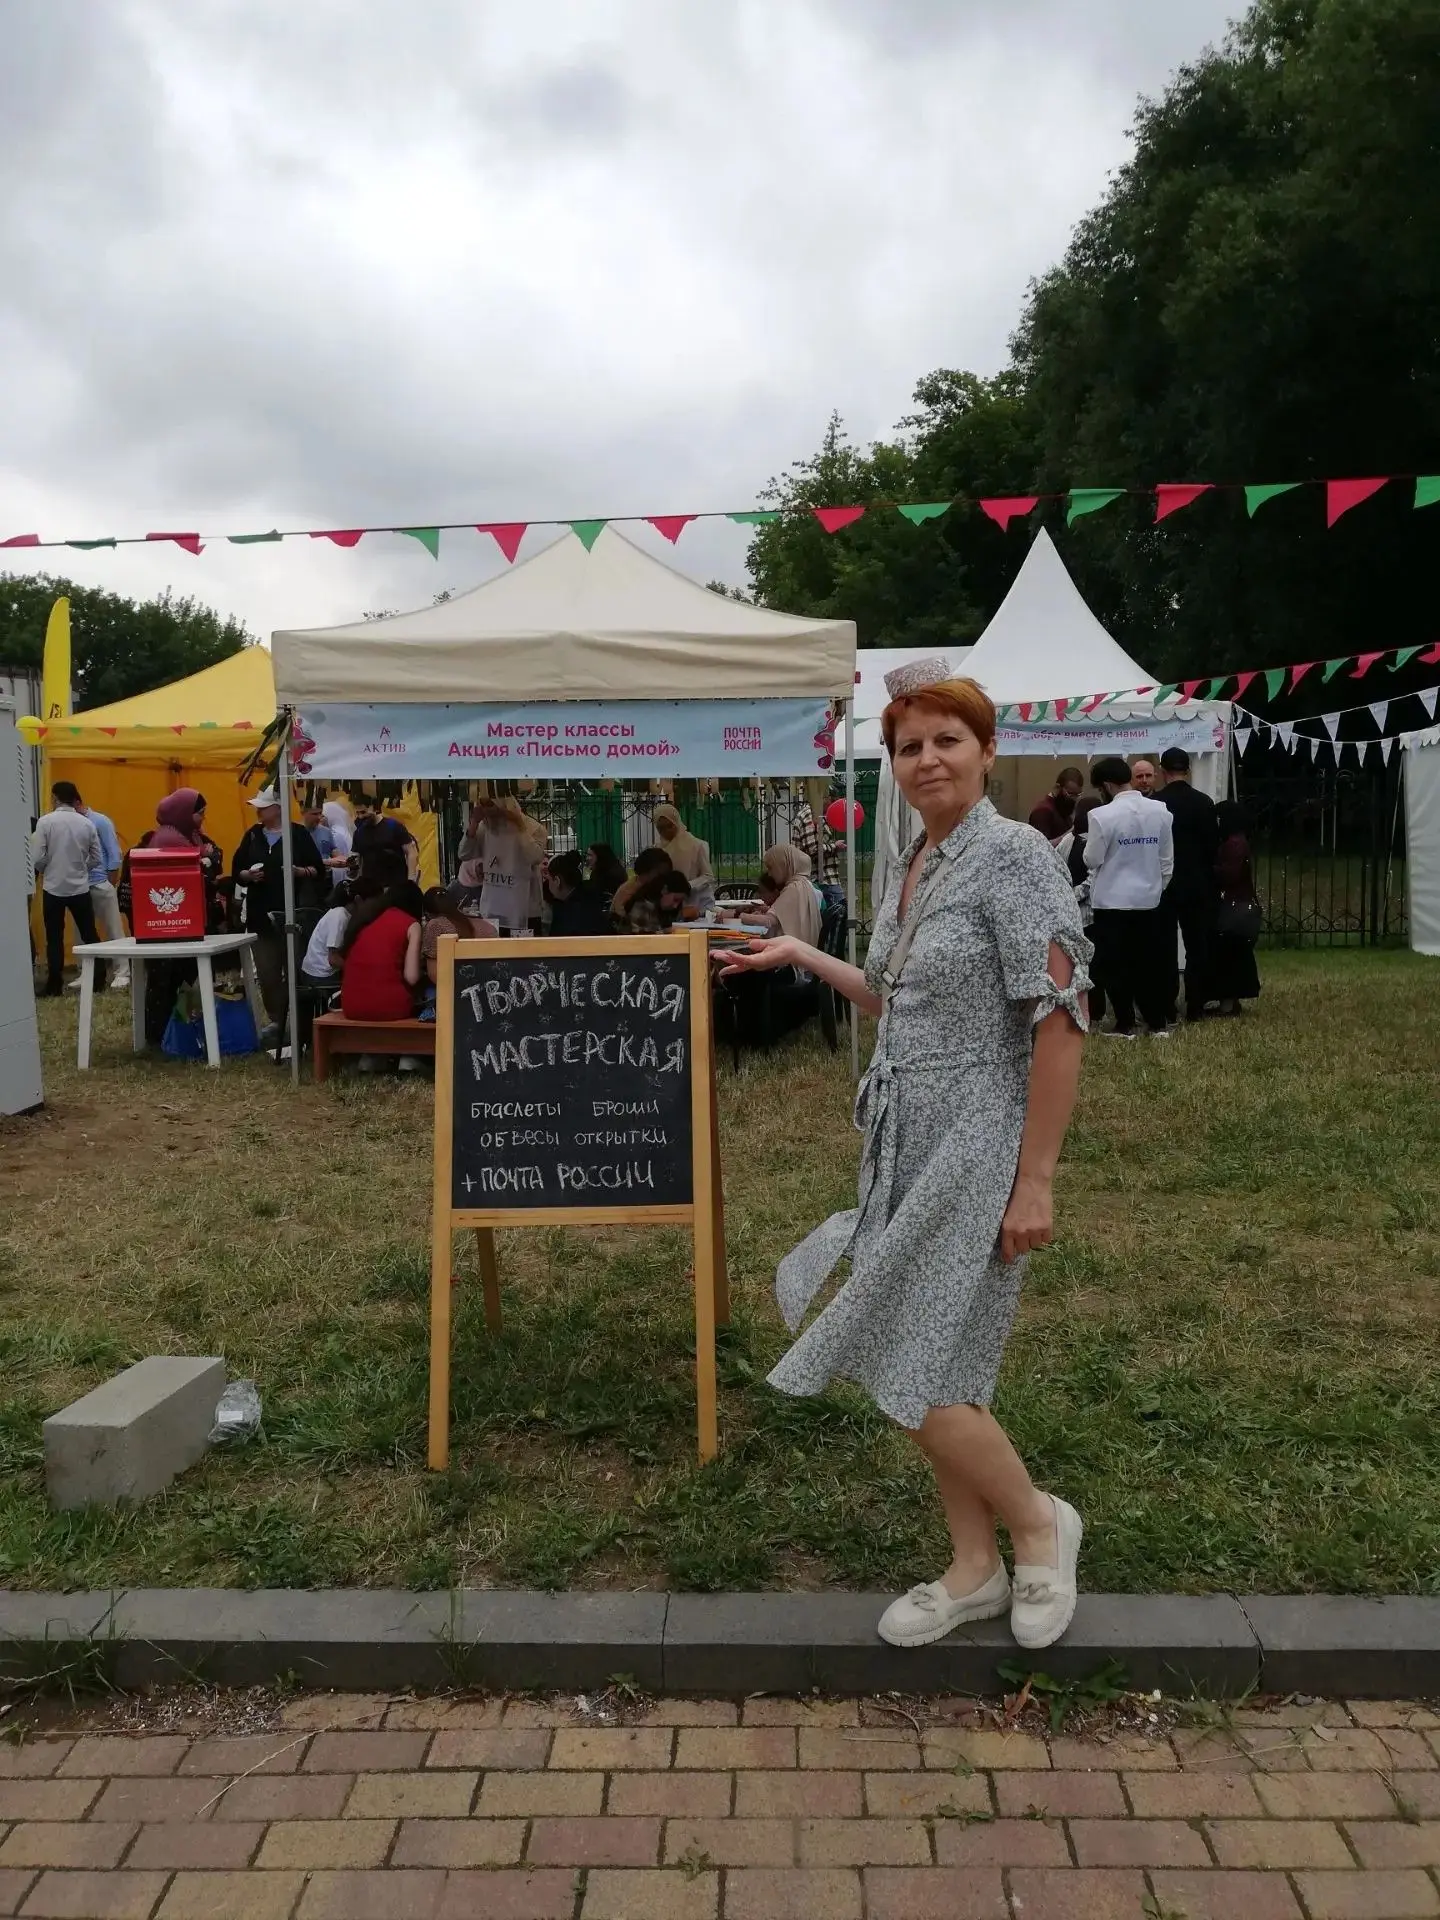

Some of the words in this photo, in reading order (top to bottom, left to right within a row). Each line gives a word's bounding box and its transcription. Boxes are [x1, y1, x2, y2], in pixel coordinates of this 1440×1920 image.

[487, 723, 558, 740] Мастер
[565, 724, 635, 737] классы
[724, 727, 761, 738] ПОЧТА
[1116, 728, 1148, 738] нами!
[363, 744, 406, 753] АКТИВ
[448, 743, 508, 758] Акция
[517, 742, 600, 757] «Письмо
[607, 740, 680, 758] домой»
[724, 739, 761, 750] РОССИИ
[1118, 837, 1158, 845] VOLUNTEER
[461, 971, 685, 1022] ТВОРЧЕСКАЯ
[471, 1031, 685, 1080] МАСТЕРСКАЯ
[557, 1161, 654, 1190] РОССИИ
